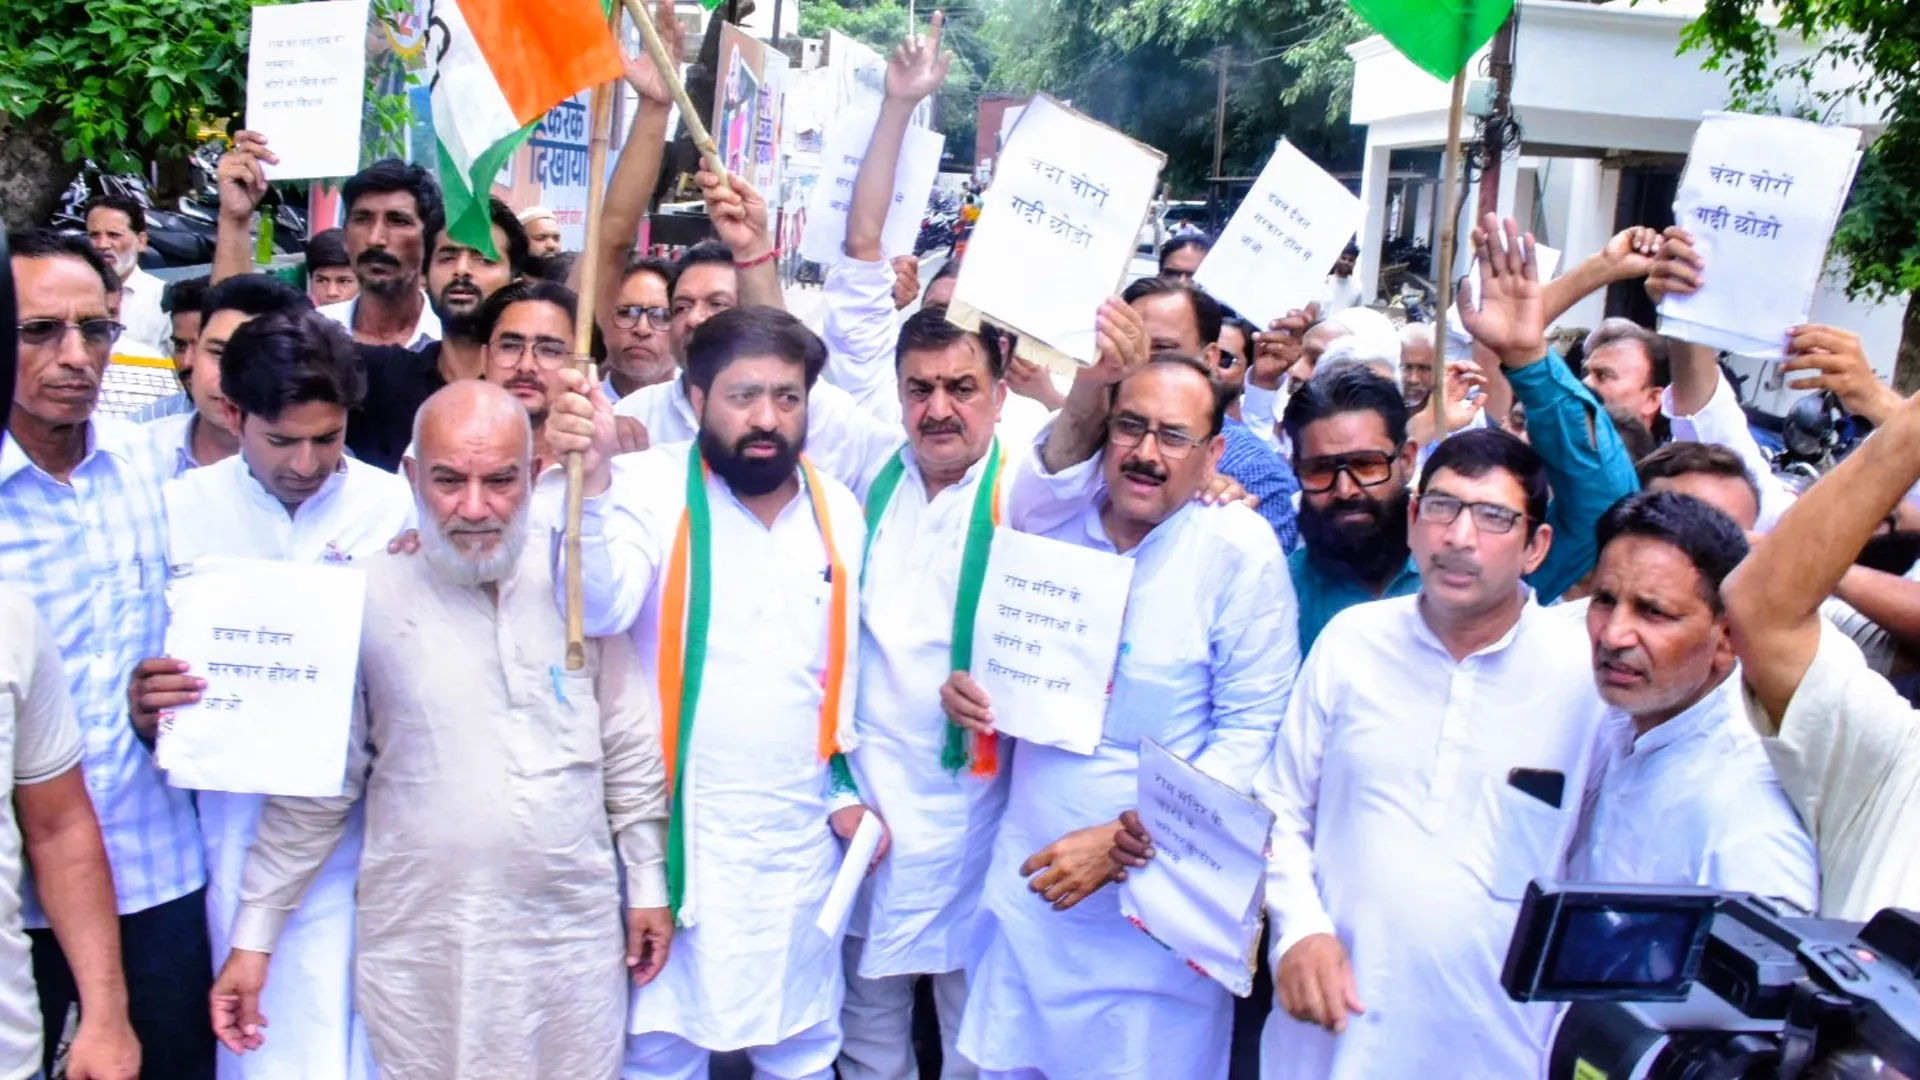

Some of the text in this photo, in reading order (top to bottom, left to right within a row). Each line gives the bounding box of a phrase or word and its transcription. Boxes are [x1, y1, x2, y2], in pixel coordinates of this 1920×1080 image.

[547, 93, 586, 140] करके
[527, 122, 589, 190] दिखाया
[1029, 156, 1109, 207] चंदा चोरों
[1710, 164, 1793, 196] चंदा चोरों
[1011, 196, 1093, 247] गद्दी छोड़ो
[1696, 205, 1782, 239] गद्दी छोड़ो
[1004, 575, 1028, 589] राम
[1031, 579, 1067, 598] मंदिर
[998, 604, 1022, 618] दान
[211, 627, 251, 642] डबल
[207, 662, 318, 683] सरकार होश में
[987, 658, 1071, 692] गिरफ्तार करो
[1154, 773, 1176, 795] राम
